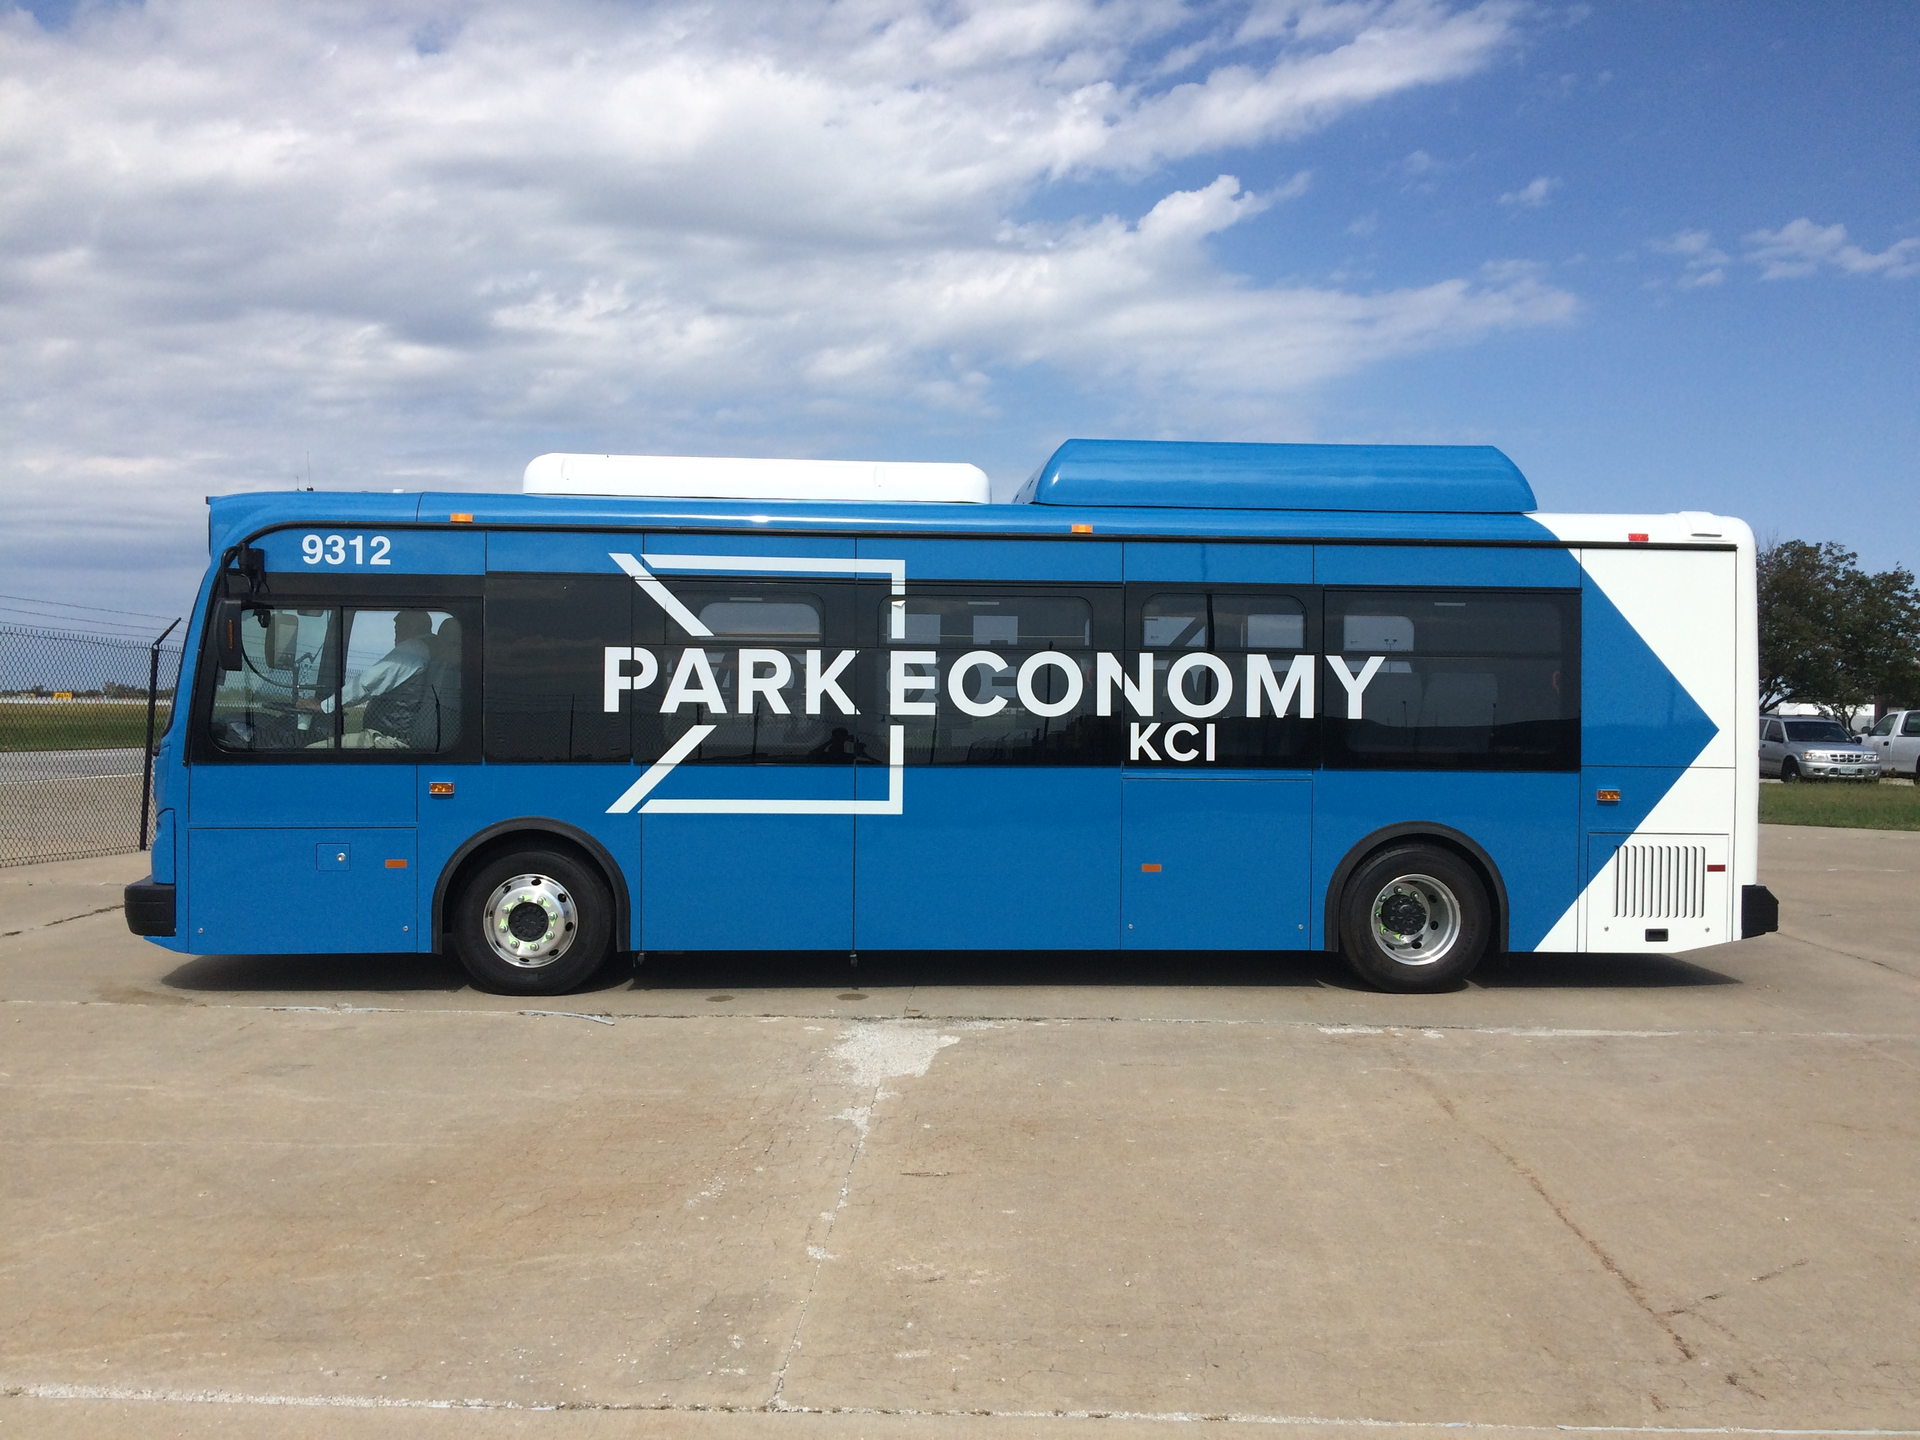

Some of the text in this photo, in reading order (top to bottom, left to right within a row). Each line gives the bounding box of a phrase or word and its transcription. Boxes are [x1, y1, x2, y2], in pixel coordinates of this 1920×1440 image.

[301, 534, 391, 566] 9312
[603, 646, 1386, 721] PARK ECONOMY
[1129, 722, 1216, 763] KCI
